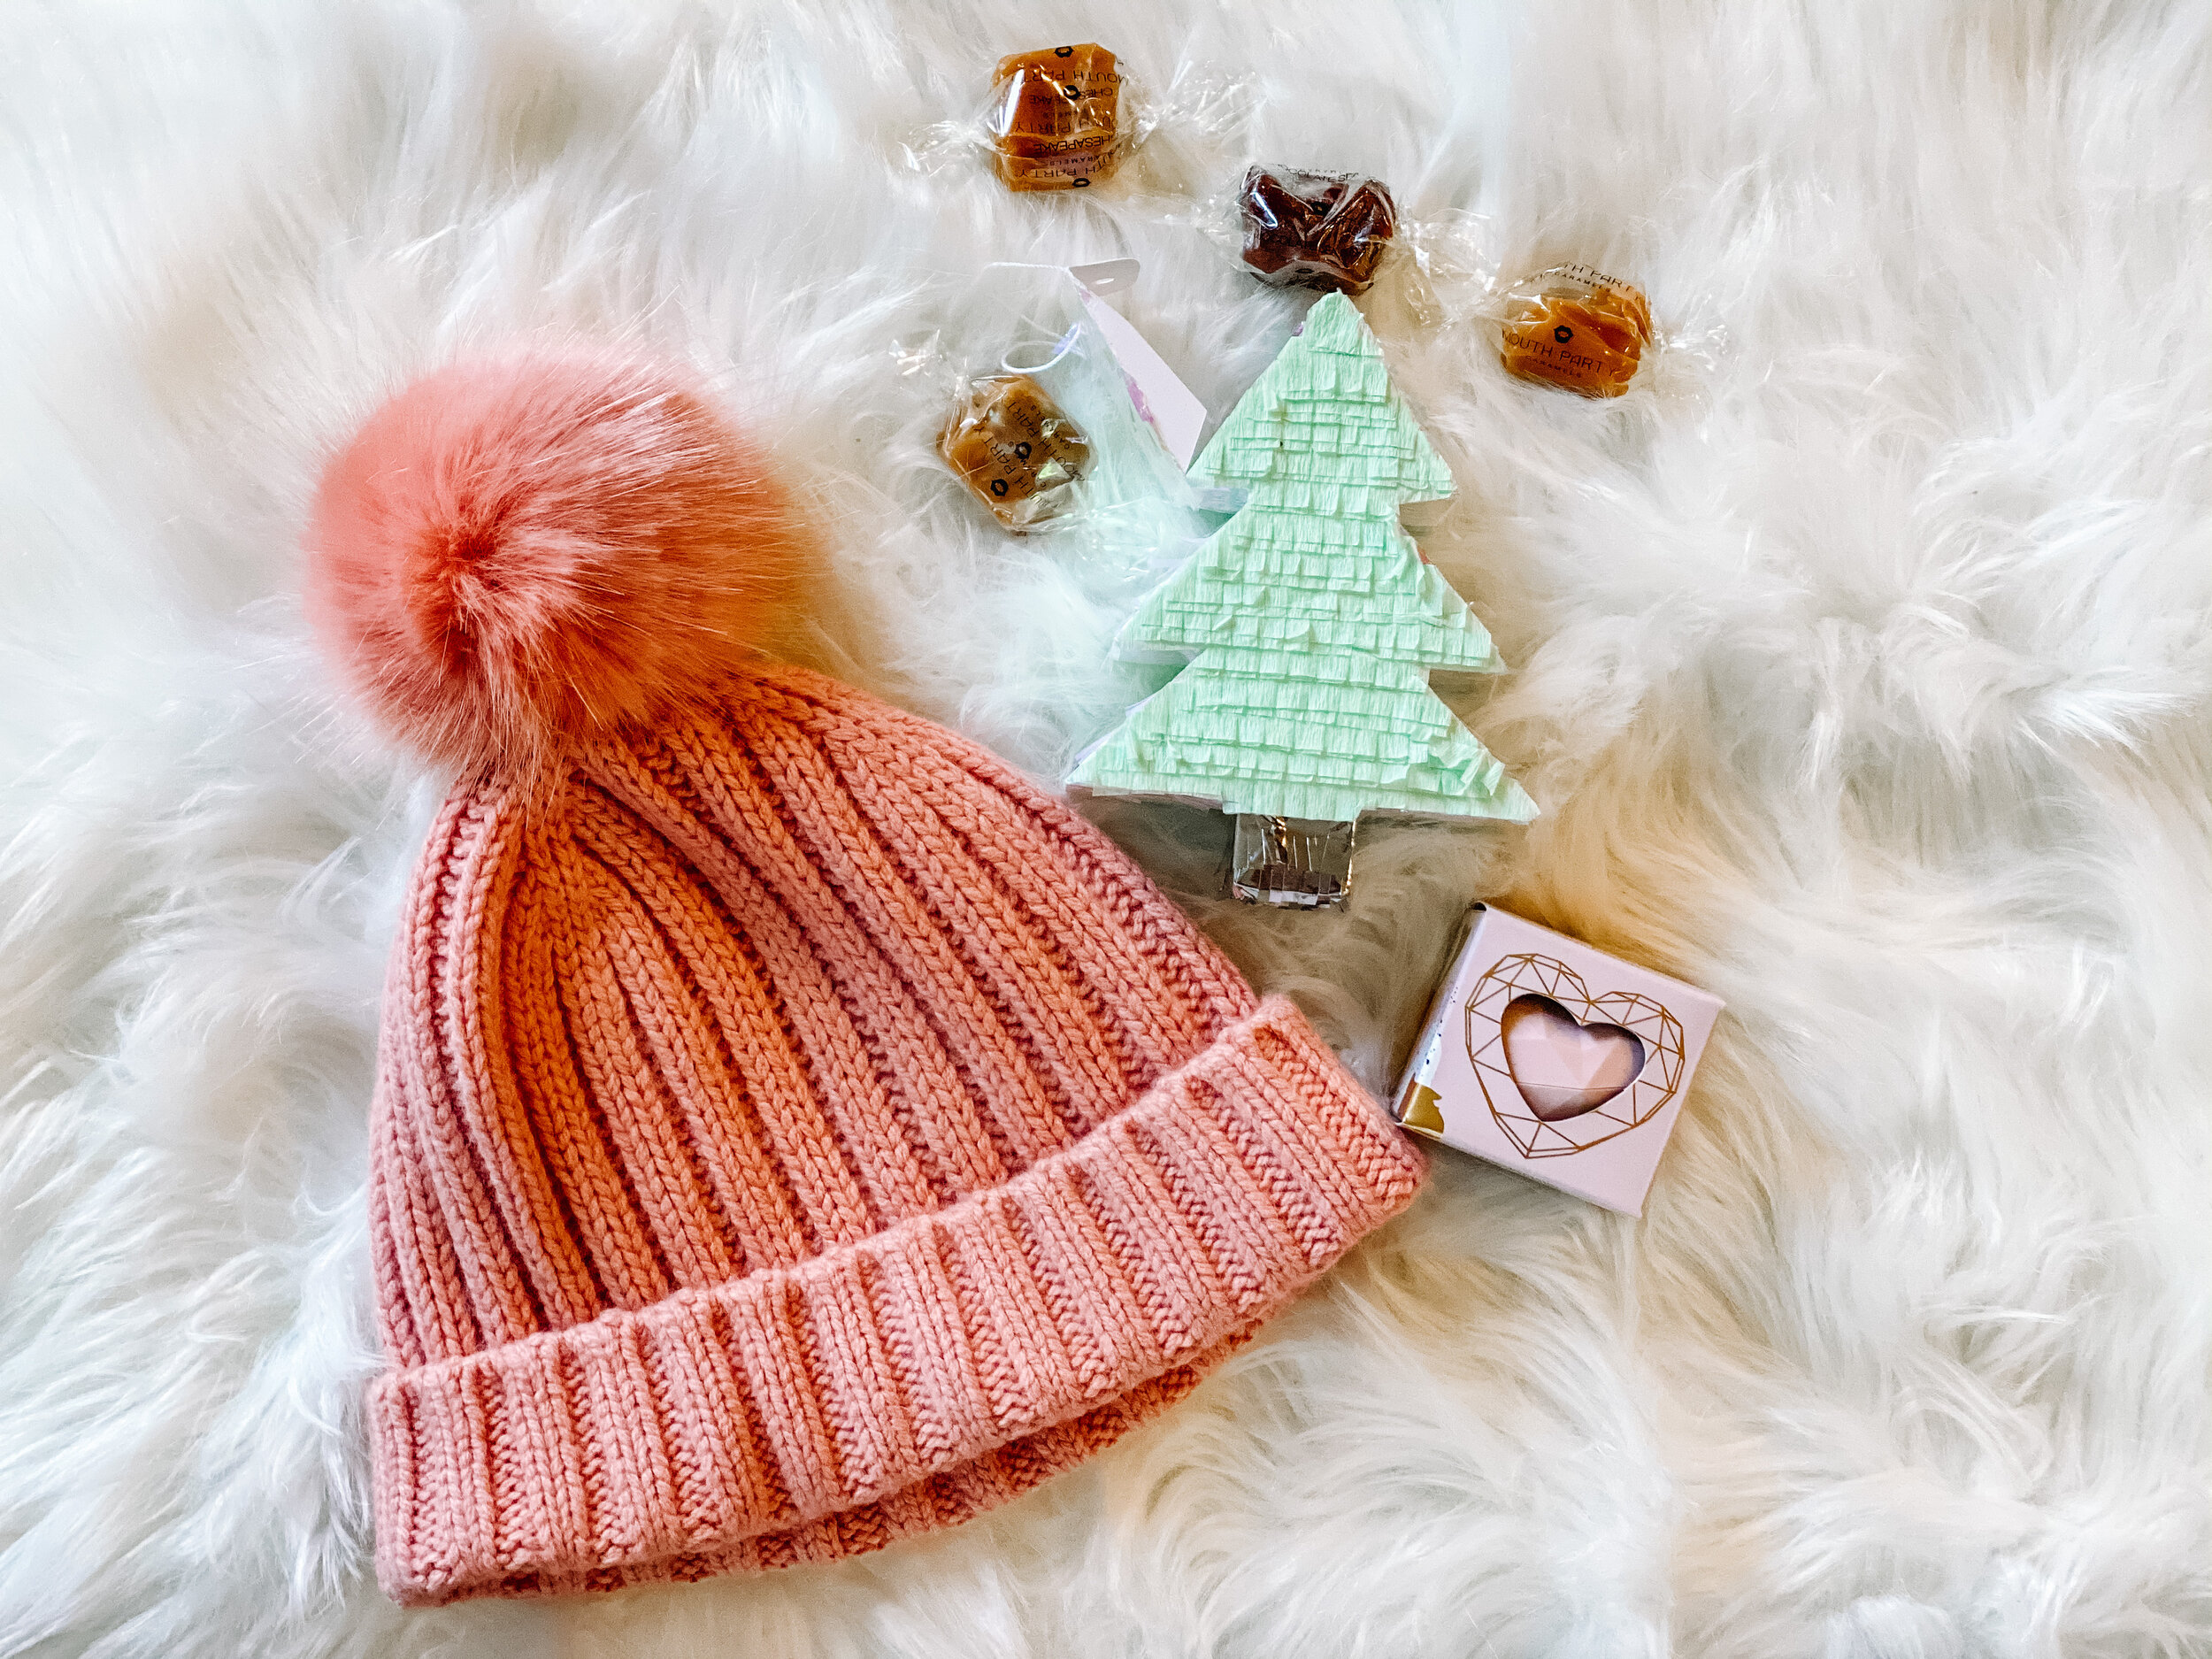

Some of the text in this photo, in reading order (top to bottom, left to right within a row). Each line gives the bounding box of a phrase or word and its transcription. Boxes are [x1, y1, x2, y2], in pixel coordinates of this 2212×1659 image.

[1033, 134, 1115, 154] HESAPEAKE
[1018, 168, 1077, 178] PARTY
[1502, 328, 1617, 377] MOUTH PARTY
[973, 426, 1017, 475] PARTY
